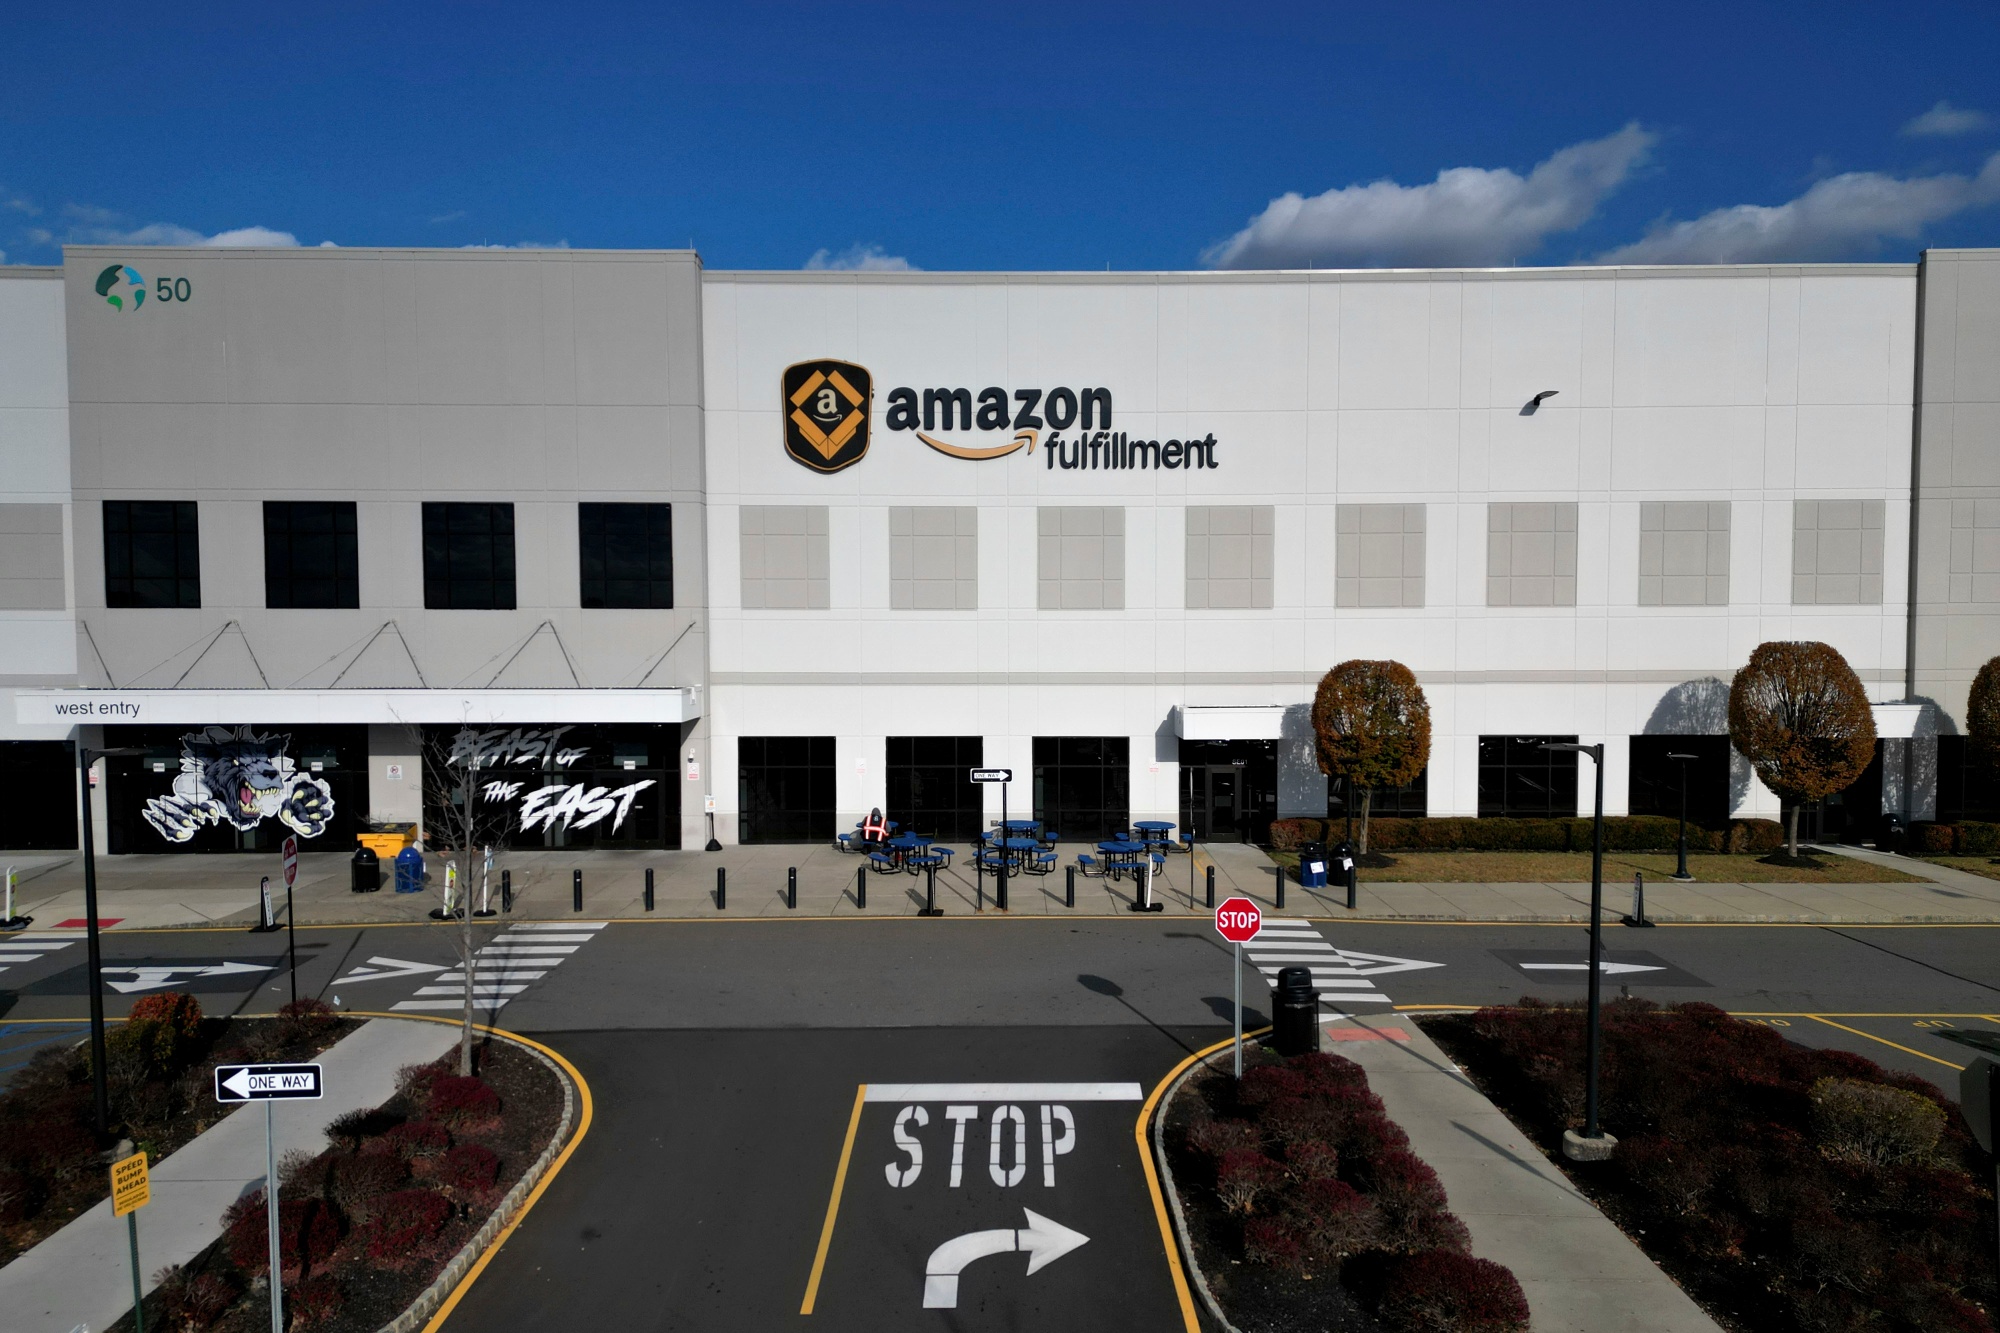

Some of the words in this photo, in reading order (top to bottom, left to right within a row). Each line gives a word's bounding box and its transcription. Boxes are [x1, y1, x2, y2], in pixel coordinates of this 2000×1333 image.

[156, 277, 192, 302] 50
[816, 388, 838, 414] a
[886, 386, 1112, 431] amazon
[1044, 432, 1219, 470] fulfillment
[55, 701, 94, 714] west
[99, 701, 140, 718] entry
[445, 725, 577, 769] BEAST
[555, 746, 592, 768] OF
[481, 780, 526, 803] THE
[518, 779, 658, 836] EAST
[1219, 911, 1258, 928] STOP
[248, 1076, 276, 1090] ONE
[281, 1075, 309, 1089] WAY
[885, 1105, 1076, 1188] STOP
[115, 1159, 143, 1176] SPEED
[117, 1169, 143, 1185] BUMP
[116, 1177, 147, 1196] AHEAD
